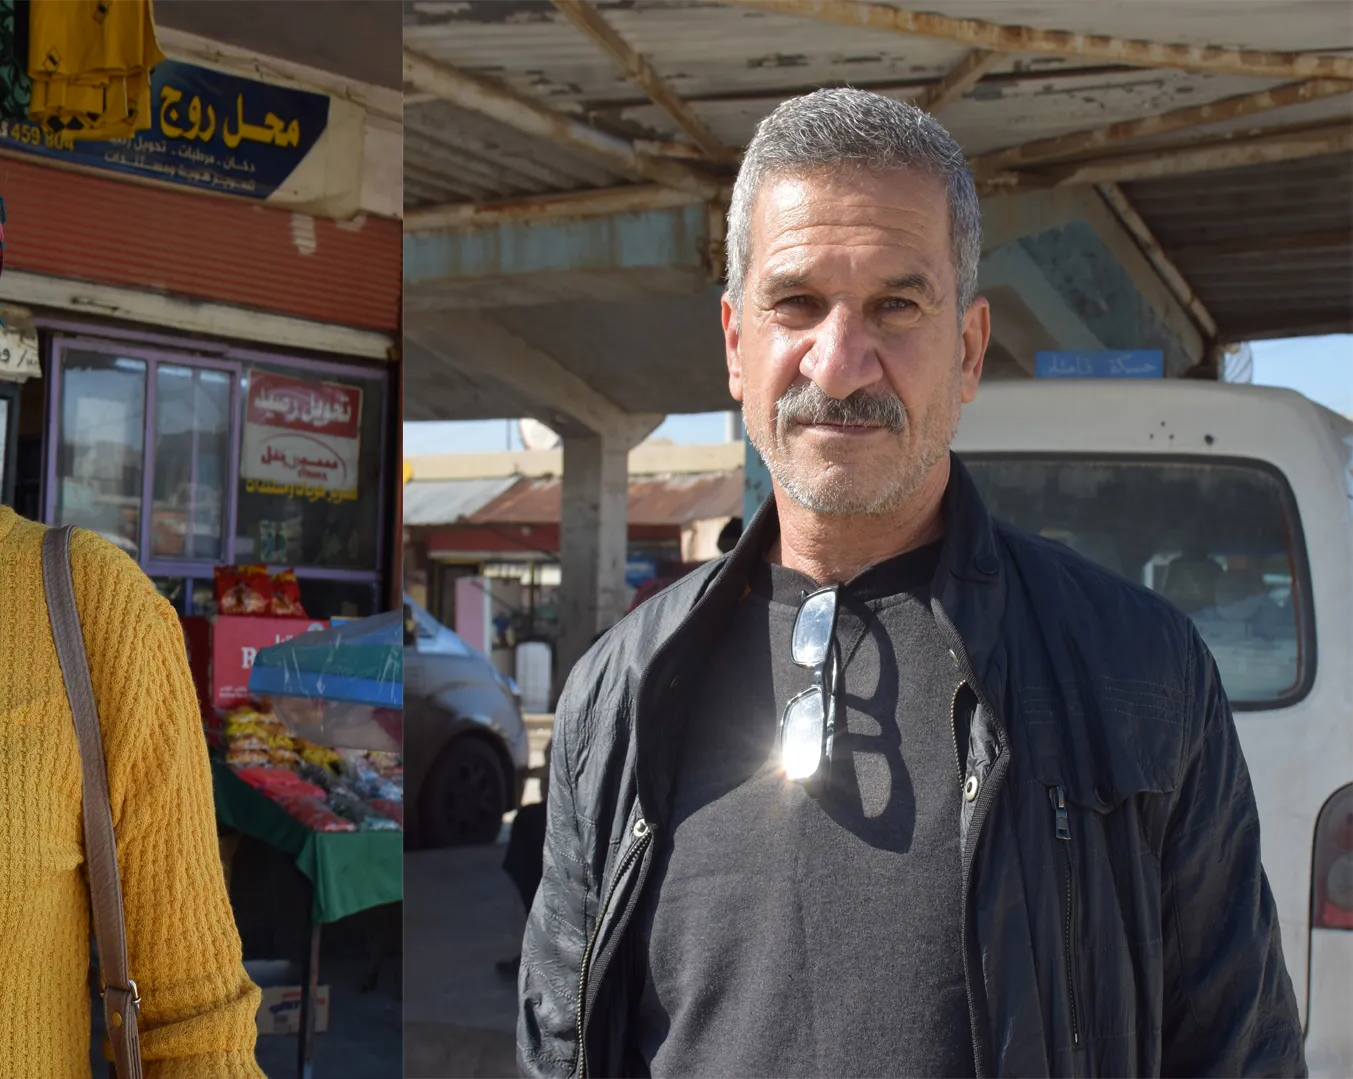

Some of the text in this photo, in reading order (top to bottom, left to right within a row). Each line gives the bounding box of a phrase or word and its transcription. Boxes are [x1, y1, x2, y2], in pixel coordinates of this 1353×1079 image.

[12, 123, 39, 146] 459
[161, 85, 299, 147] محل روج
[254, 386, 351, 426] تحويل رصيد
